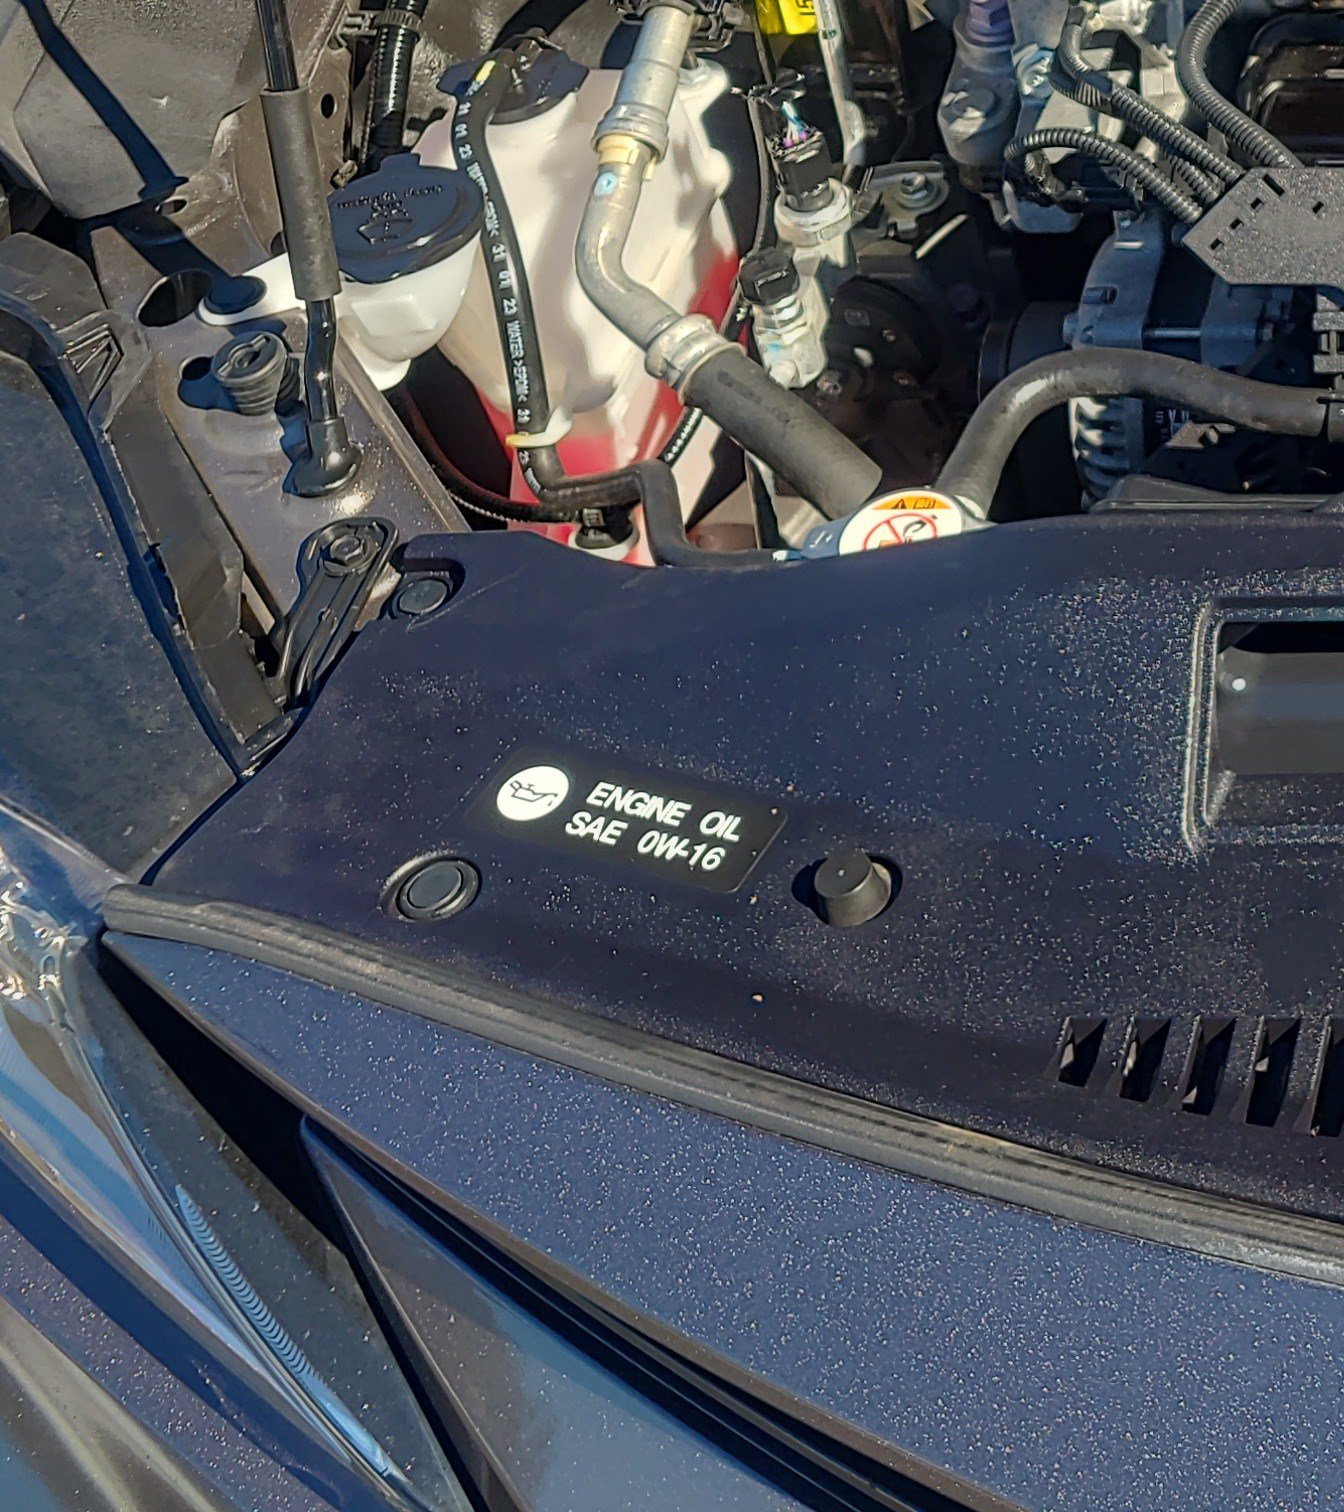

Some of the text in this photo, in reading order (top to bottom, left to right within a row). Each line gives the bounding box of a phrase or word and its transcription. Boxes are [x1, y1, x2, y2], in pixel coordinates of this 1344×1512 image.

[506, 320, 524, 359] WATER
[565, 810, 726, 871] SAE 0W-16
[586, 781, 744, 843] ENGINE OIL
